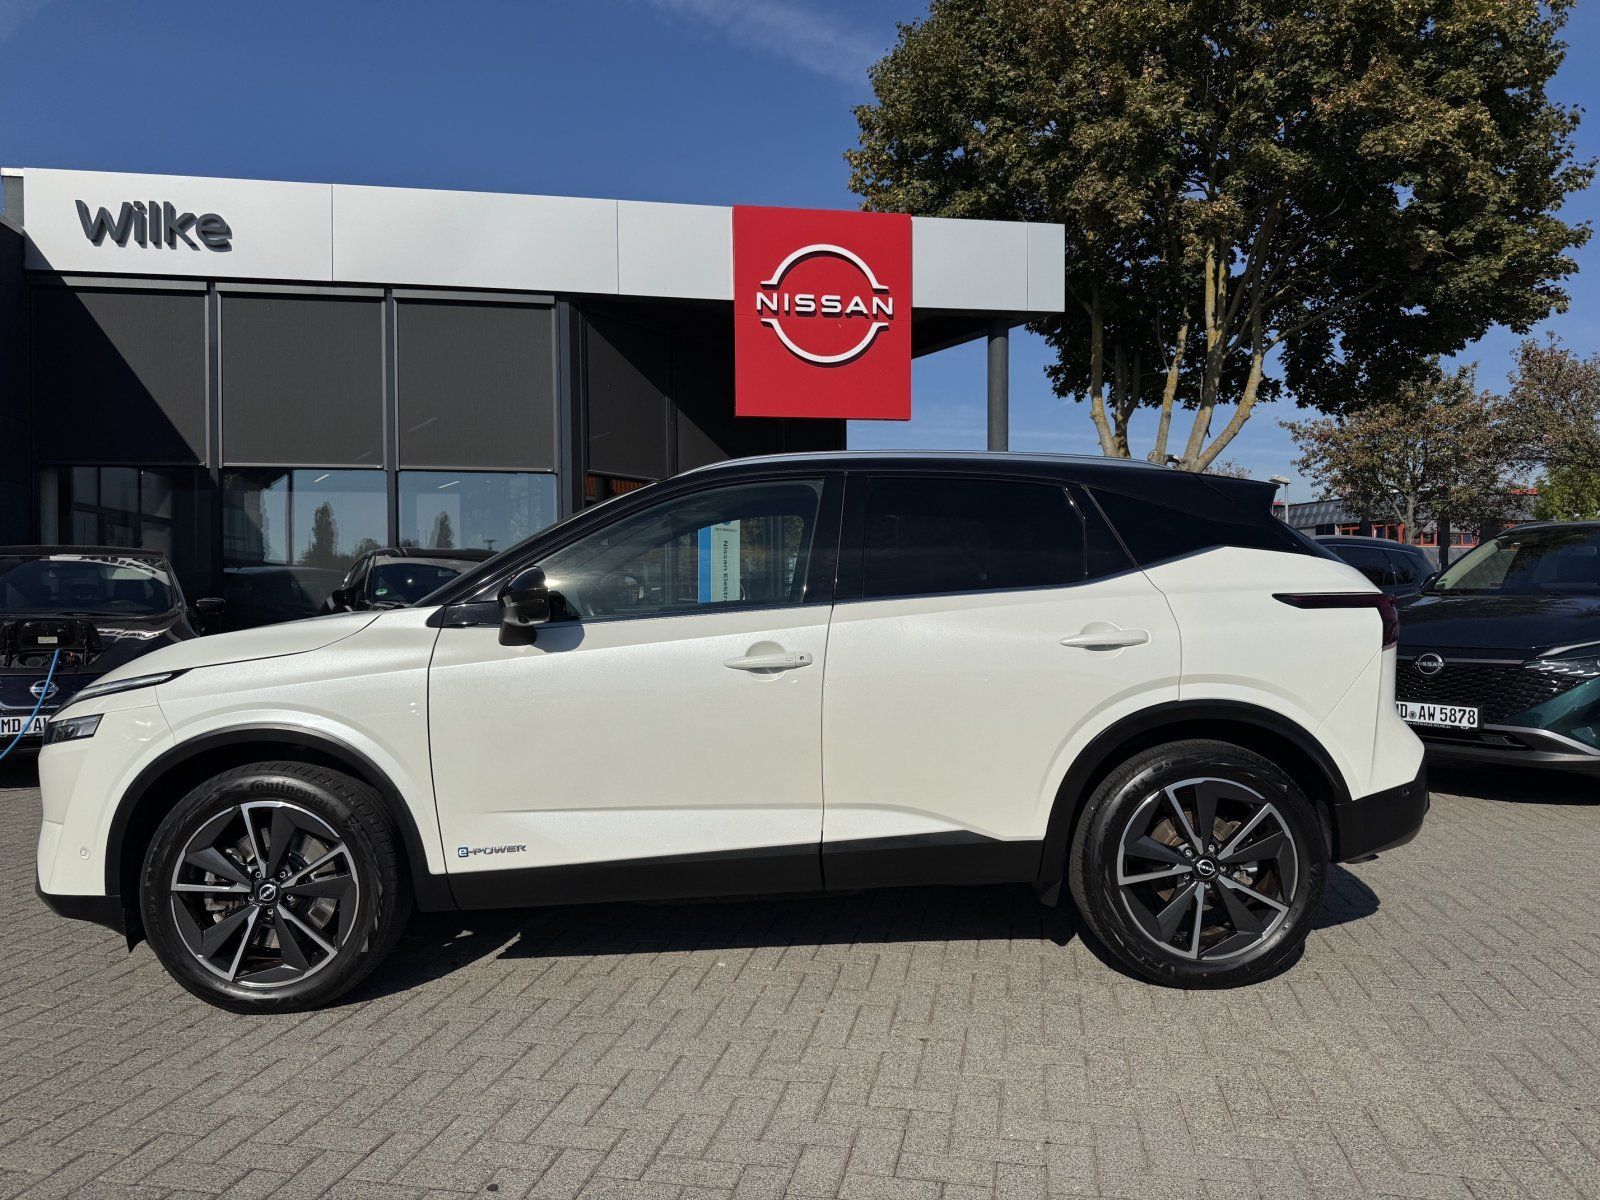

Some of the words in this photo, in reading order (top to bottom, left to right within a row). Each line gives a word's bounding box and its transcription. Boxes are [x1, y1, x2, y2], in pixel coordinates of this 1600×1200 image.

[75, 200, 233, 252] Wilke
[756, 292, 894, 318] NISSAN
[1418, 705, 1436, 721] AW
[1439, 707, 1476, 725] 5878
[1, 718, 21, 733] MD
[457, 844, 527, 858] e-POWER
